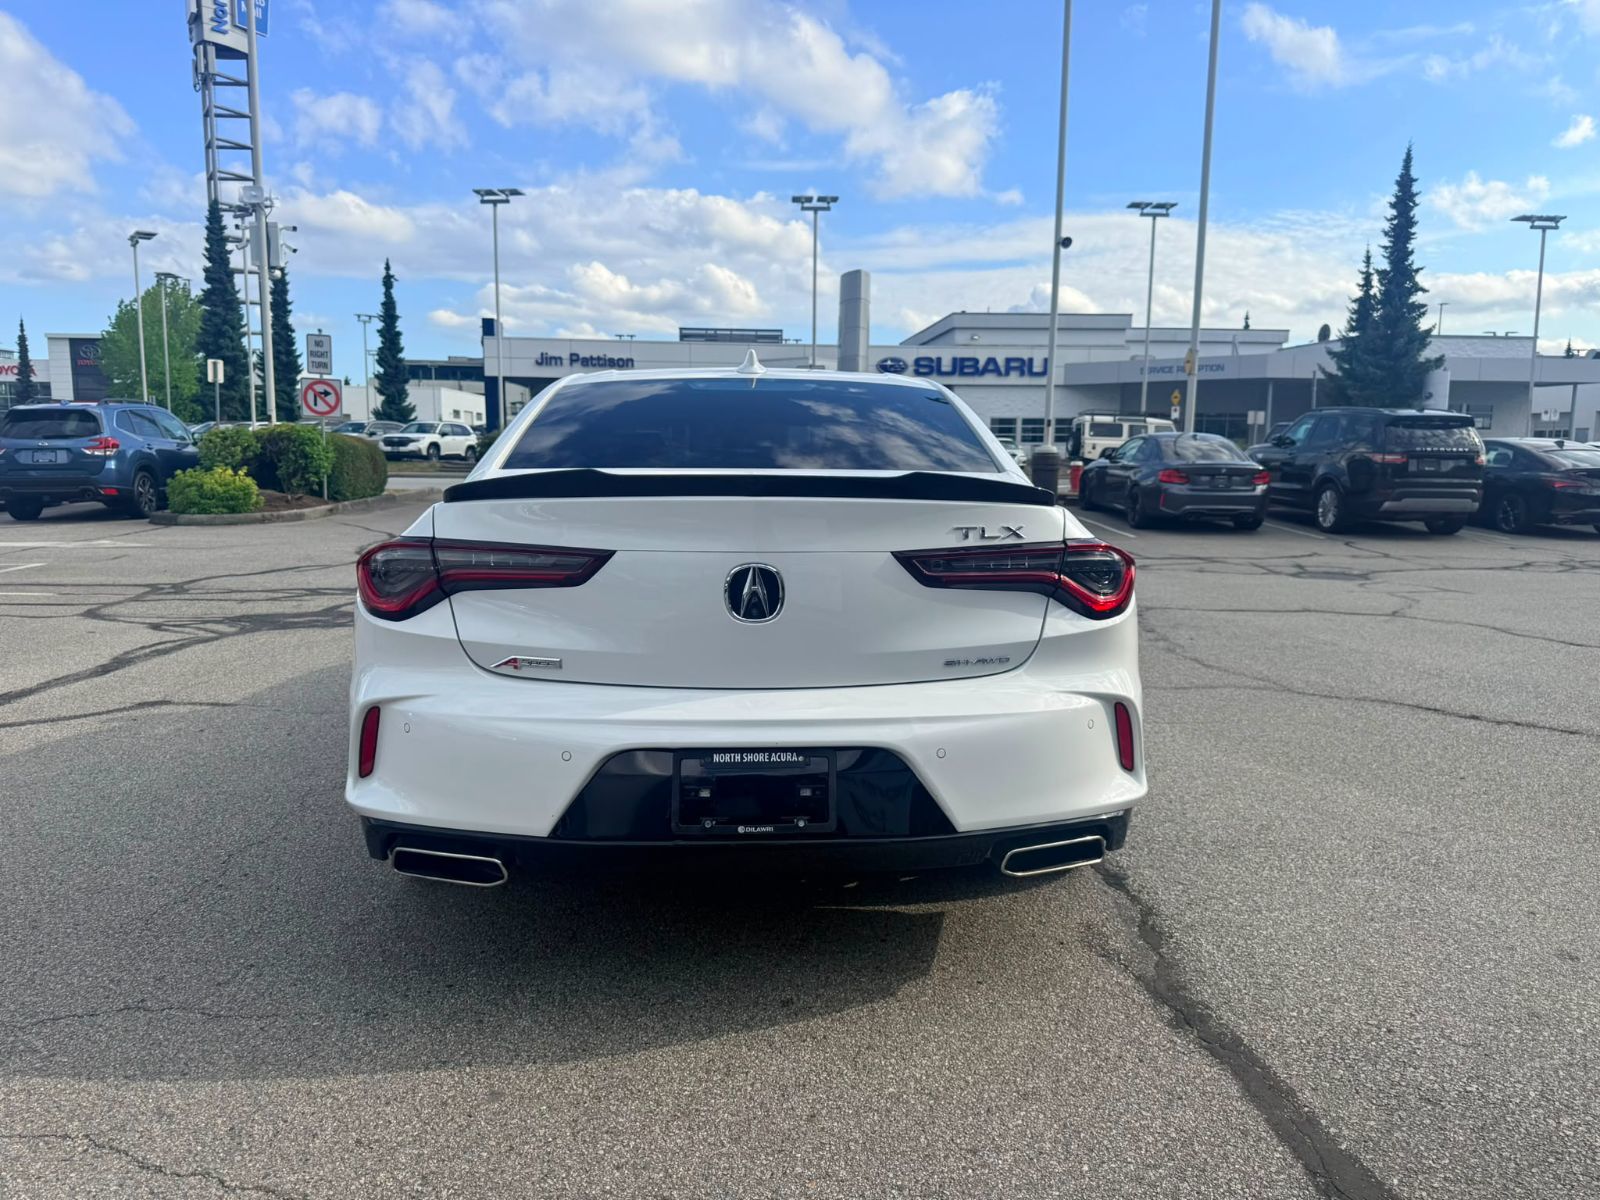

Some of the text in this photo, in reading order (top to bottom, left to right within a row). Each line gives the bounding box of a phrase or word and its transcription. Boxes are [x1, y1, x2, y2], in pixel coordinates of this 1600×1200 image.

[309, 350, 328, 358] RIGHT
[535, 352, 635, 368] Jim Pattison
[311, 361, 329, 369] TURN
[913, 356, 1048, 377] SUBARU
[945, 526, 1026, 540] TLX
[713, 752, 798, 763] NORTH SHORE ACURA
